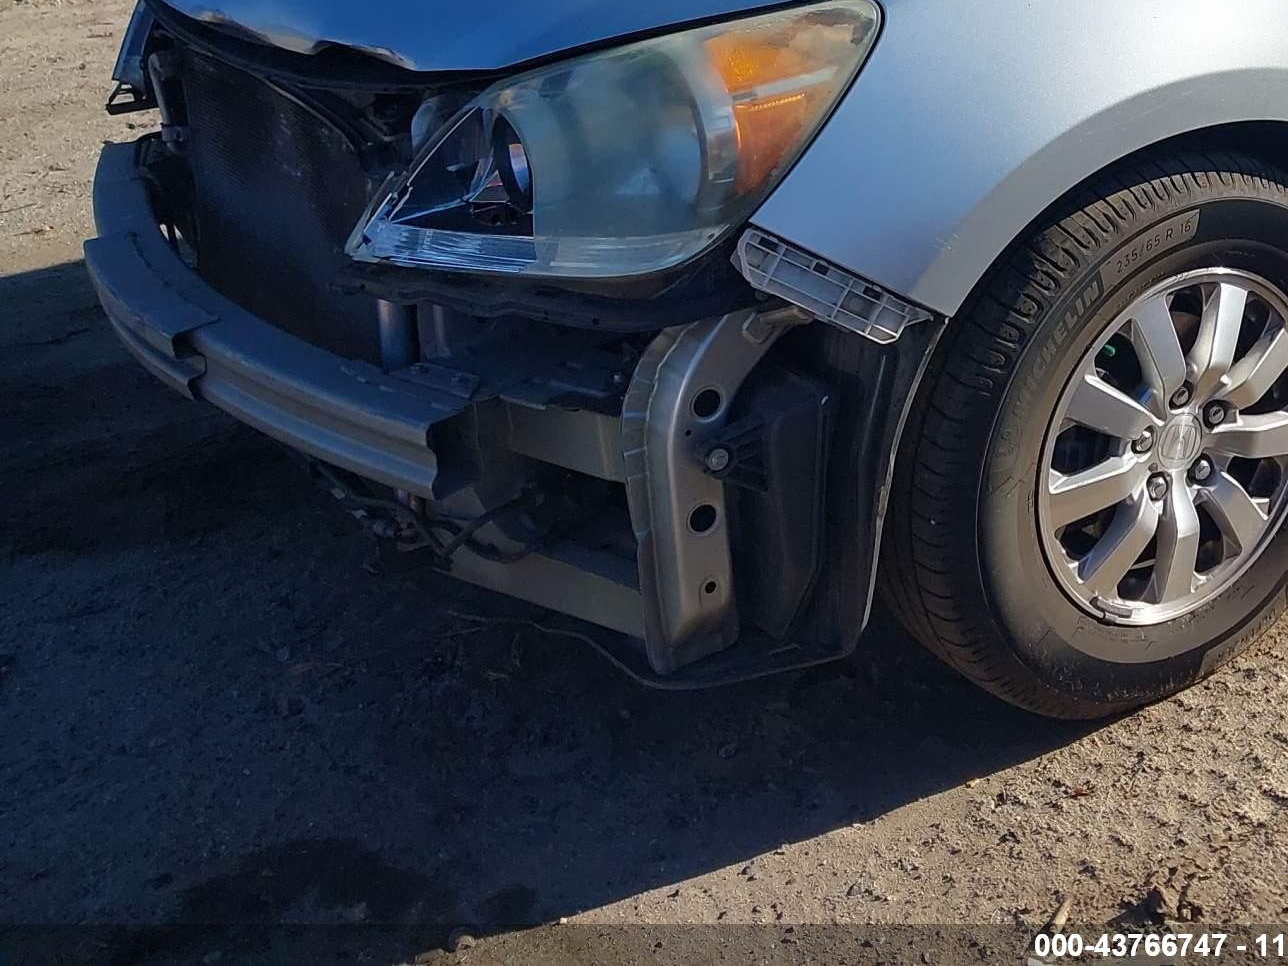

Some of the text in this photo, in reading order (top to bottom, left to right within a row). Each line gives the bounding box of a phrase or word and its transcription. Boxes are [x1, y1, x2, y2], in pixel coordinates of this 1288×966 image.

[1116, 218, 1192, 274] 235/65 R 16
[1012, 280, 1101, 420] MICHELIN
